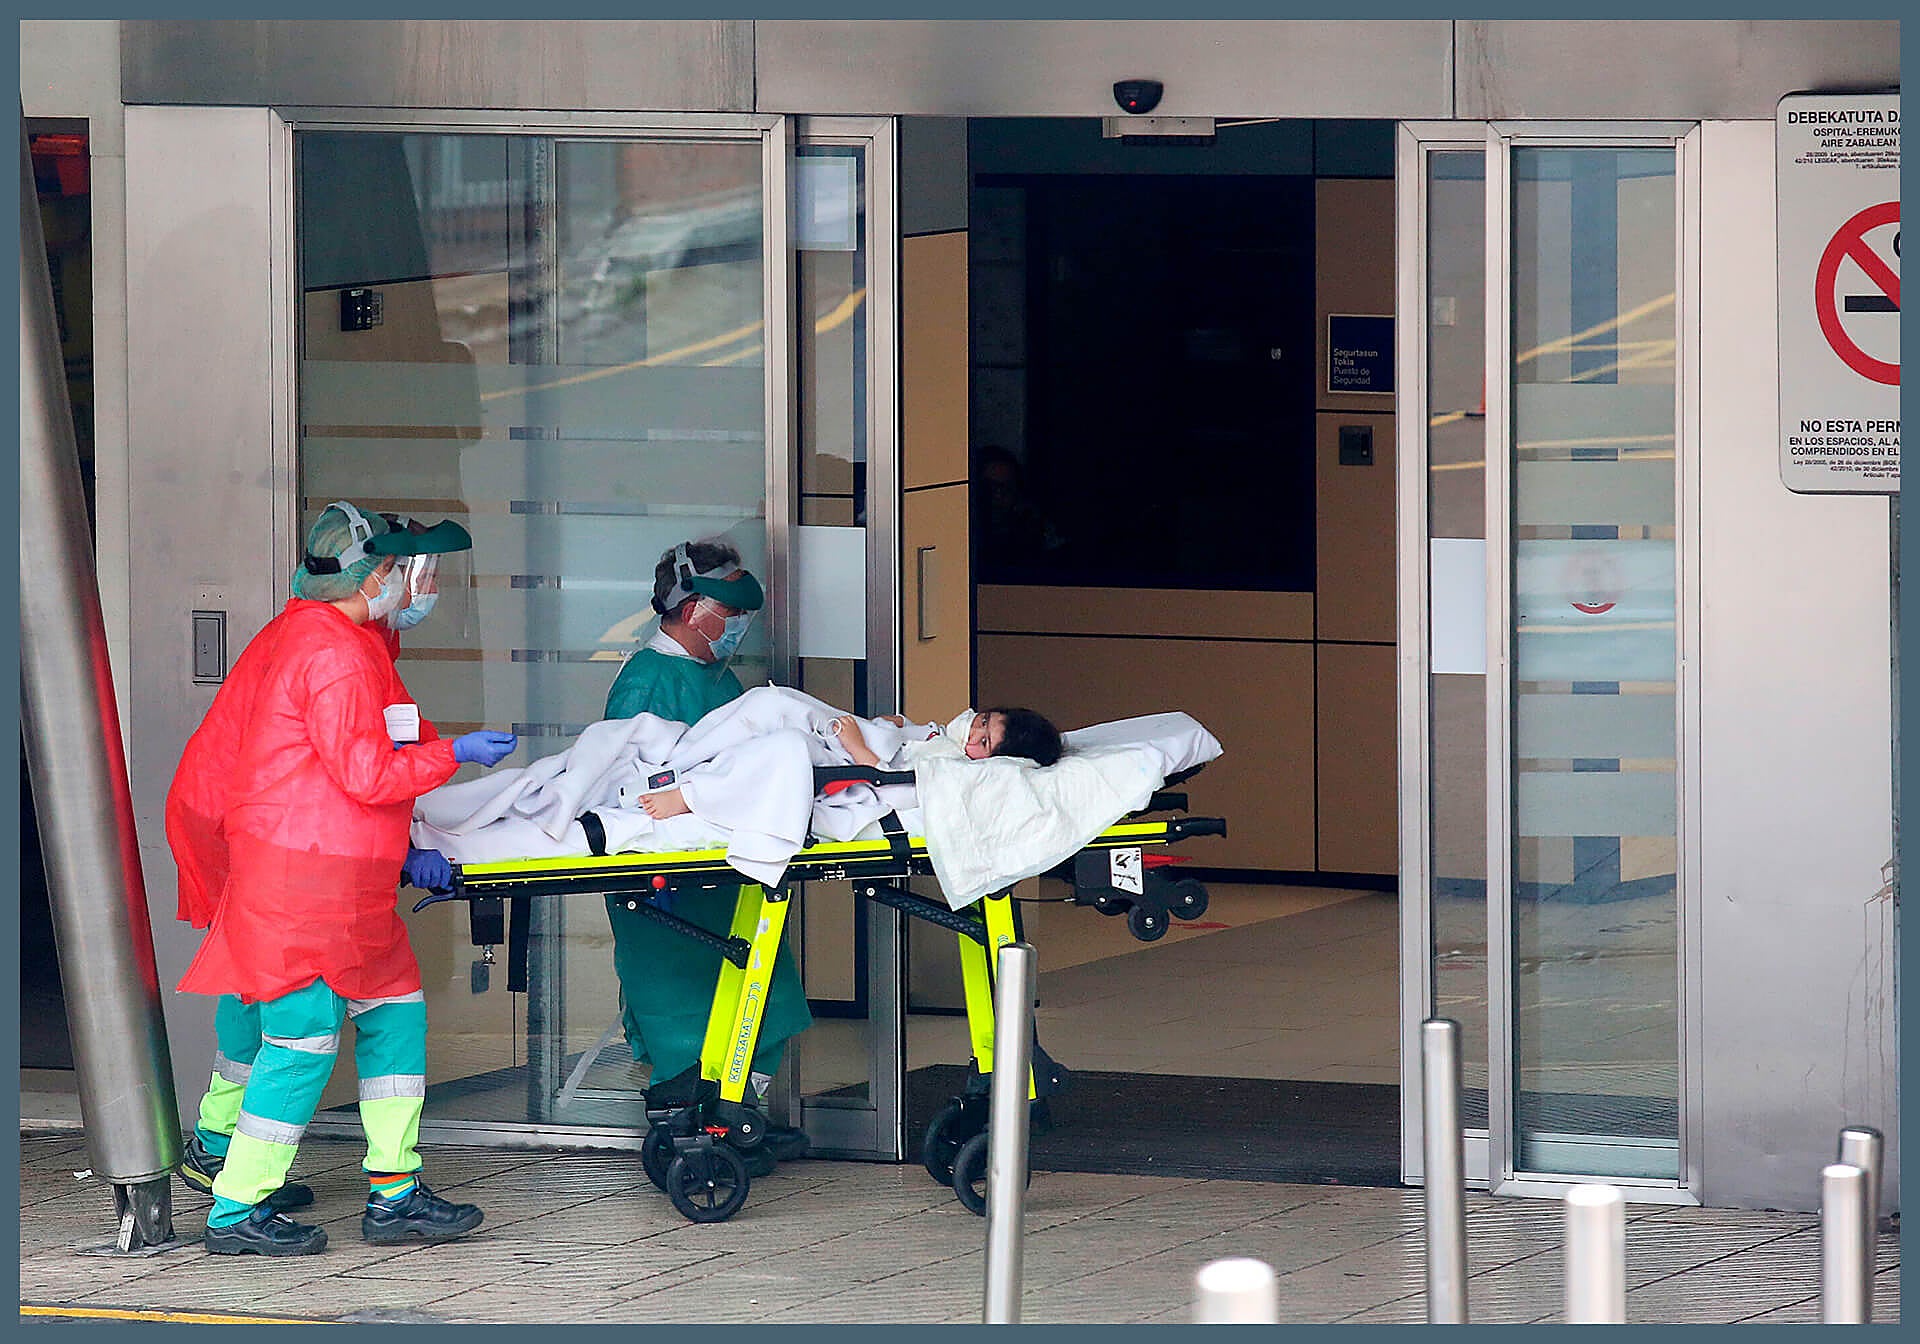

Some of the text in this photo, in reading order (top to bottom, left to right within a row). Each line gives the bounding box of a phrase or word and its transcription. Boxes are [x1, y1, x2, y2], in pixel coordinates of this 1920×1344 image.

[1788, 110, 1900, 123] DEBEKATUTA D
[1821, 139, 1843, 147] AIRE
[1845, 138, 1896, 147] ZABALEAN
[1333, 348, 1378, 358] Segurtasun
[1800, 421, 1822, 432] NO
[1826, 421, 1862, 432] ESTA
[1789, 437, 1802, 445] EN
[1805, 437, 1824, 445] LOS
[1826, 437, 1876, 446] ESPACIOS,
[1878, 437, 1890, 446] AL
[1791, 447, 1899, 455] COMPRENDIDOS EN EL
